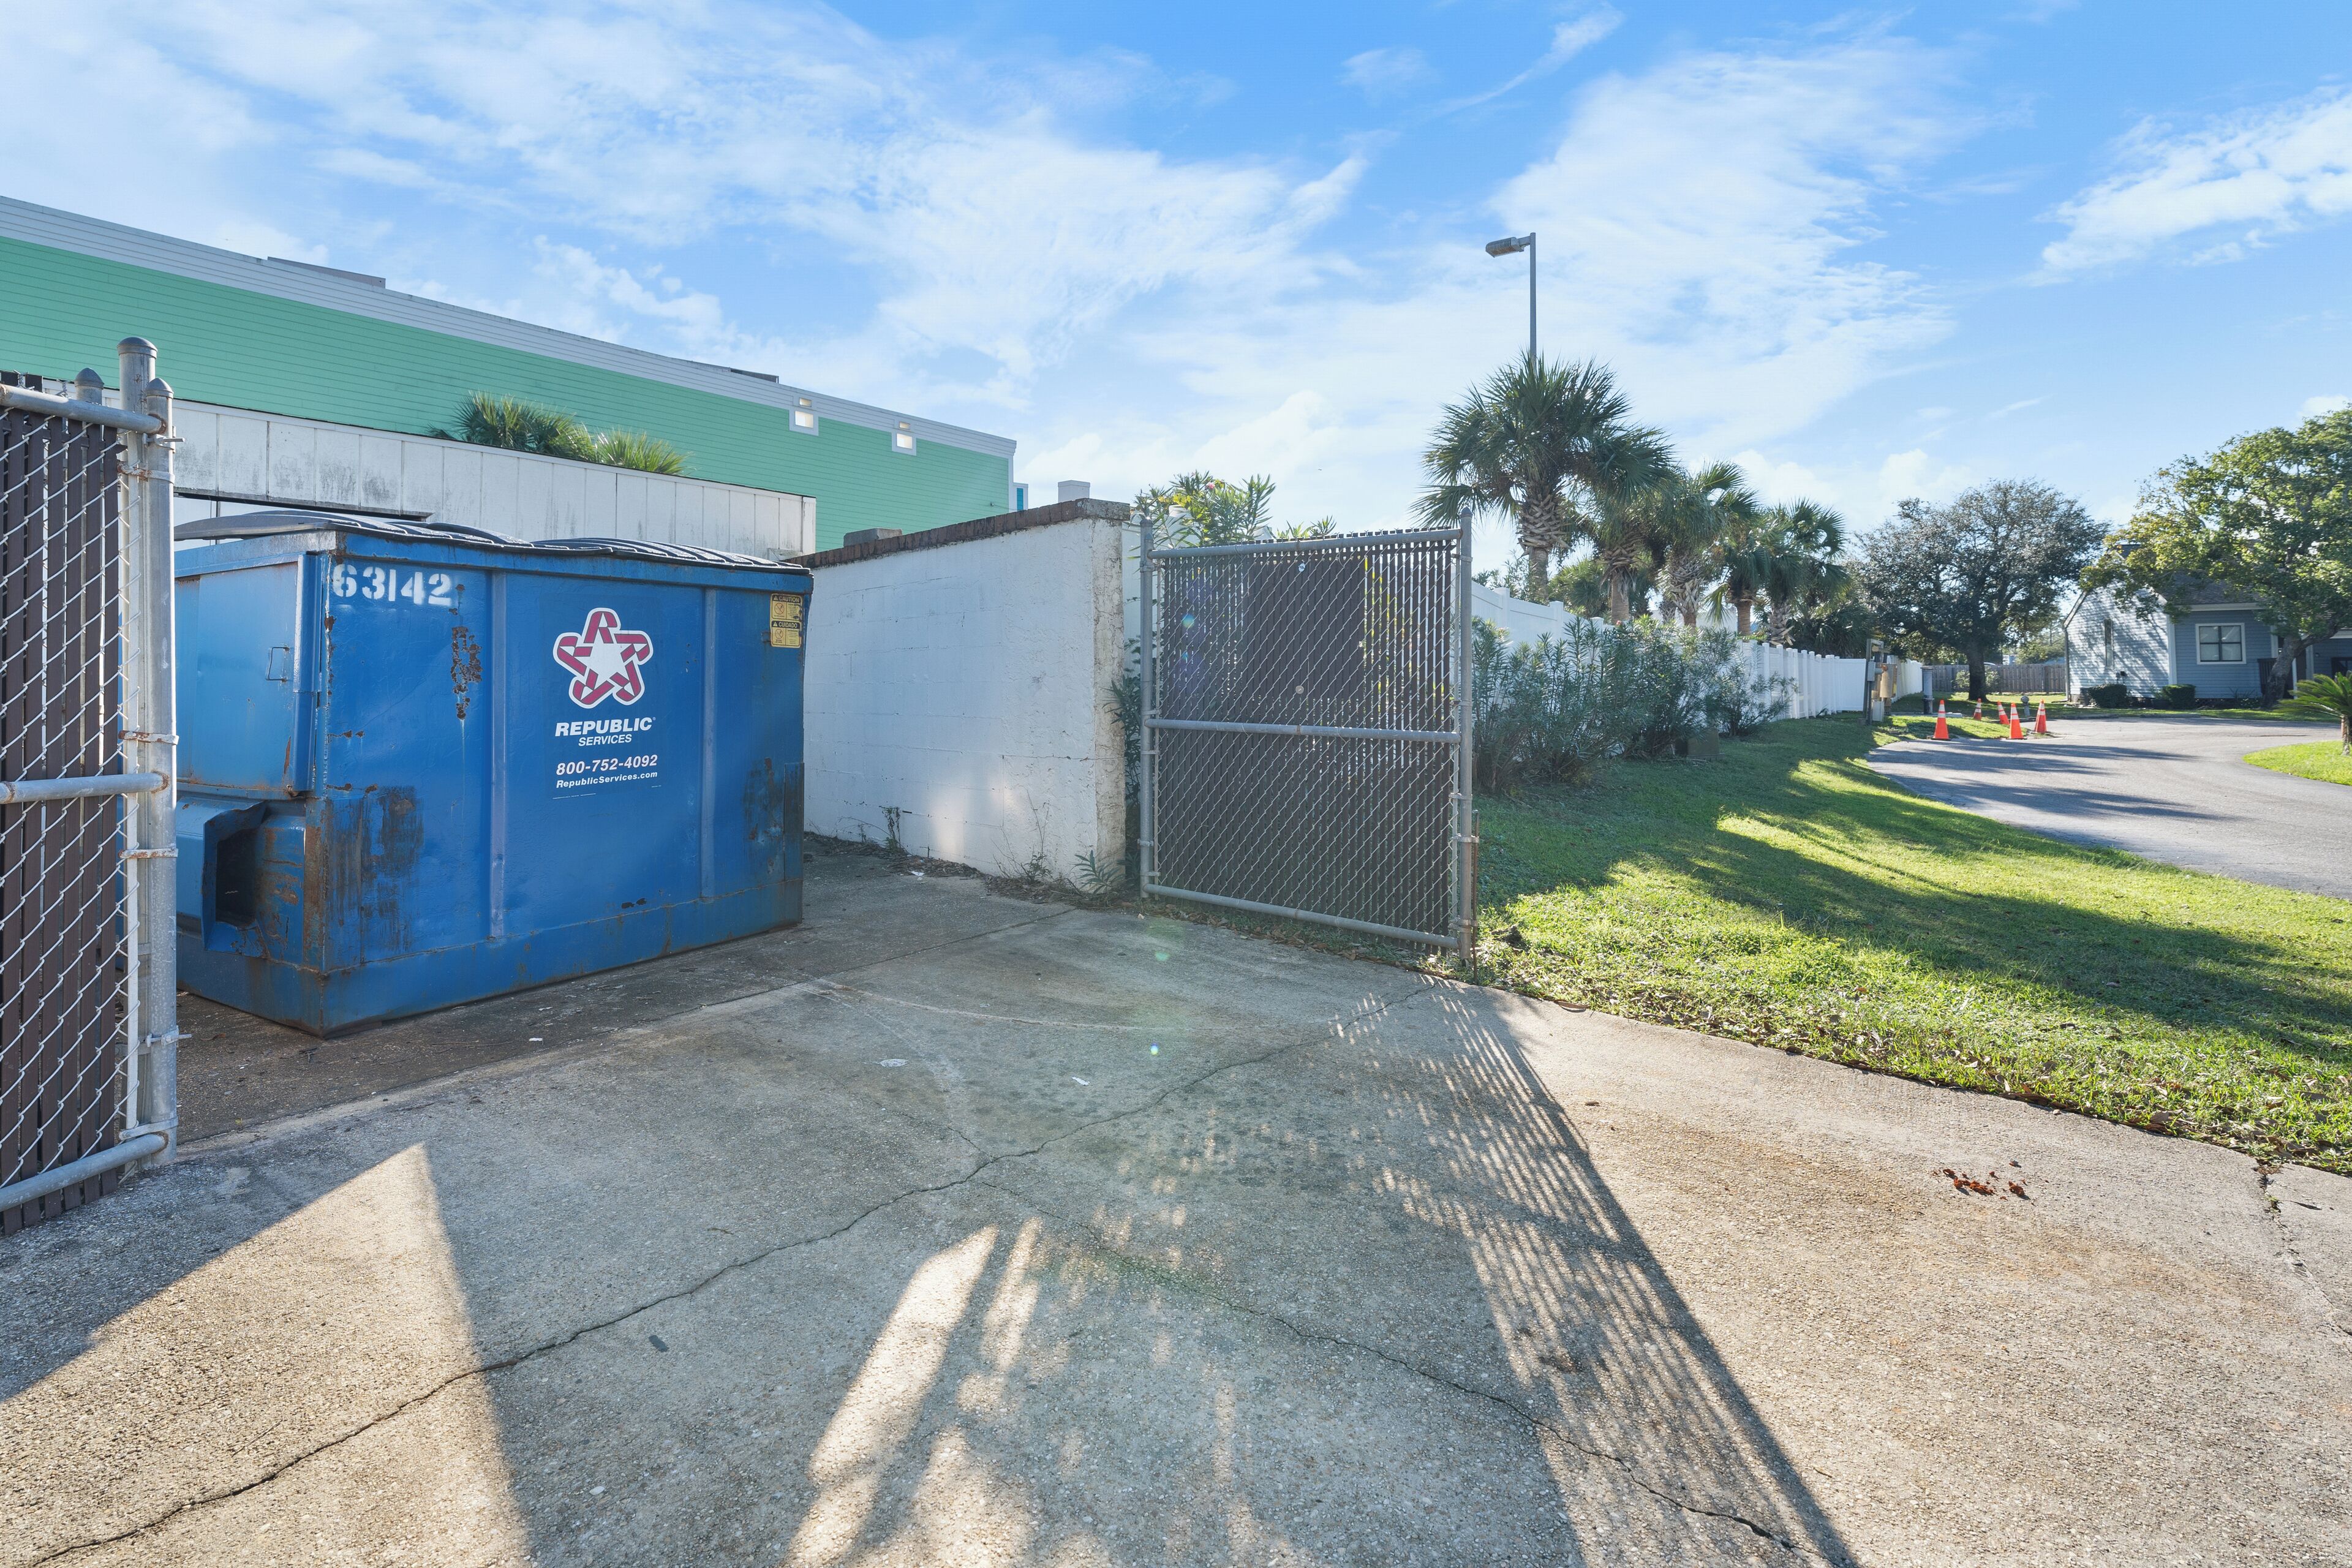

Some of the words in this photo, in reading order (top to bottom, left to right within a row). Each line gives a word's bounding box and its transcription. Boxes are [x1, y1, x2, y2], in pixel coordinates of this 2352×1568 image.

[555, 717, 652, 736] REPUBLIC
[578, 734, 632, 747] SERVICES
[556, 754, 658, 775] 800-752-4092
[556, 772, 658, 788] RepublicServices.com
